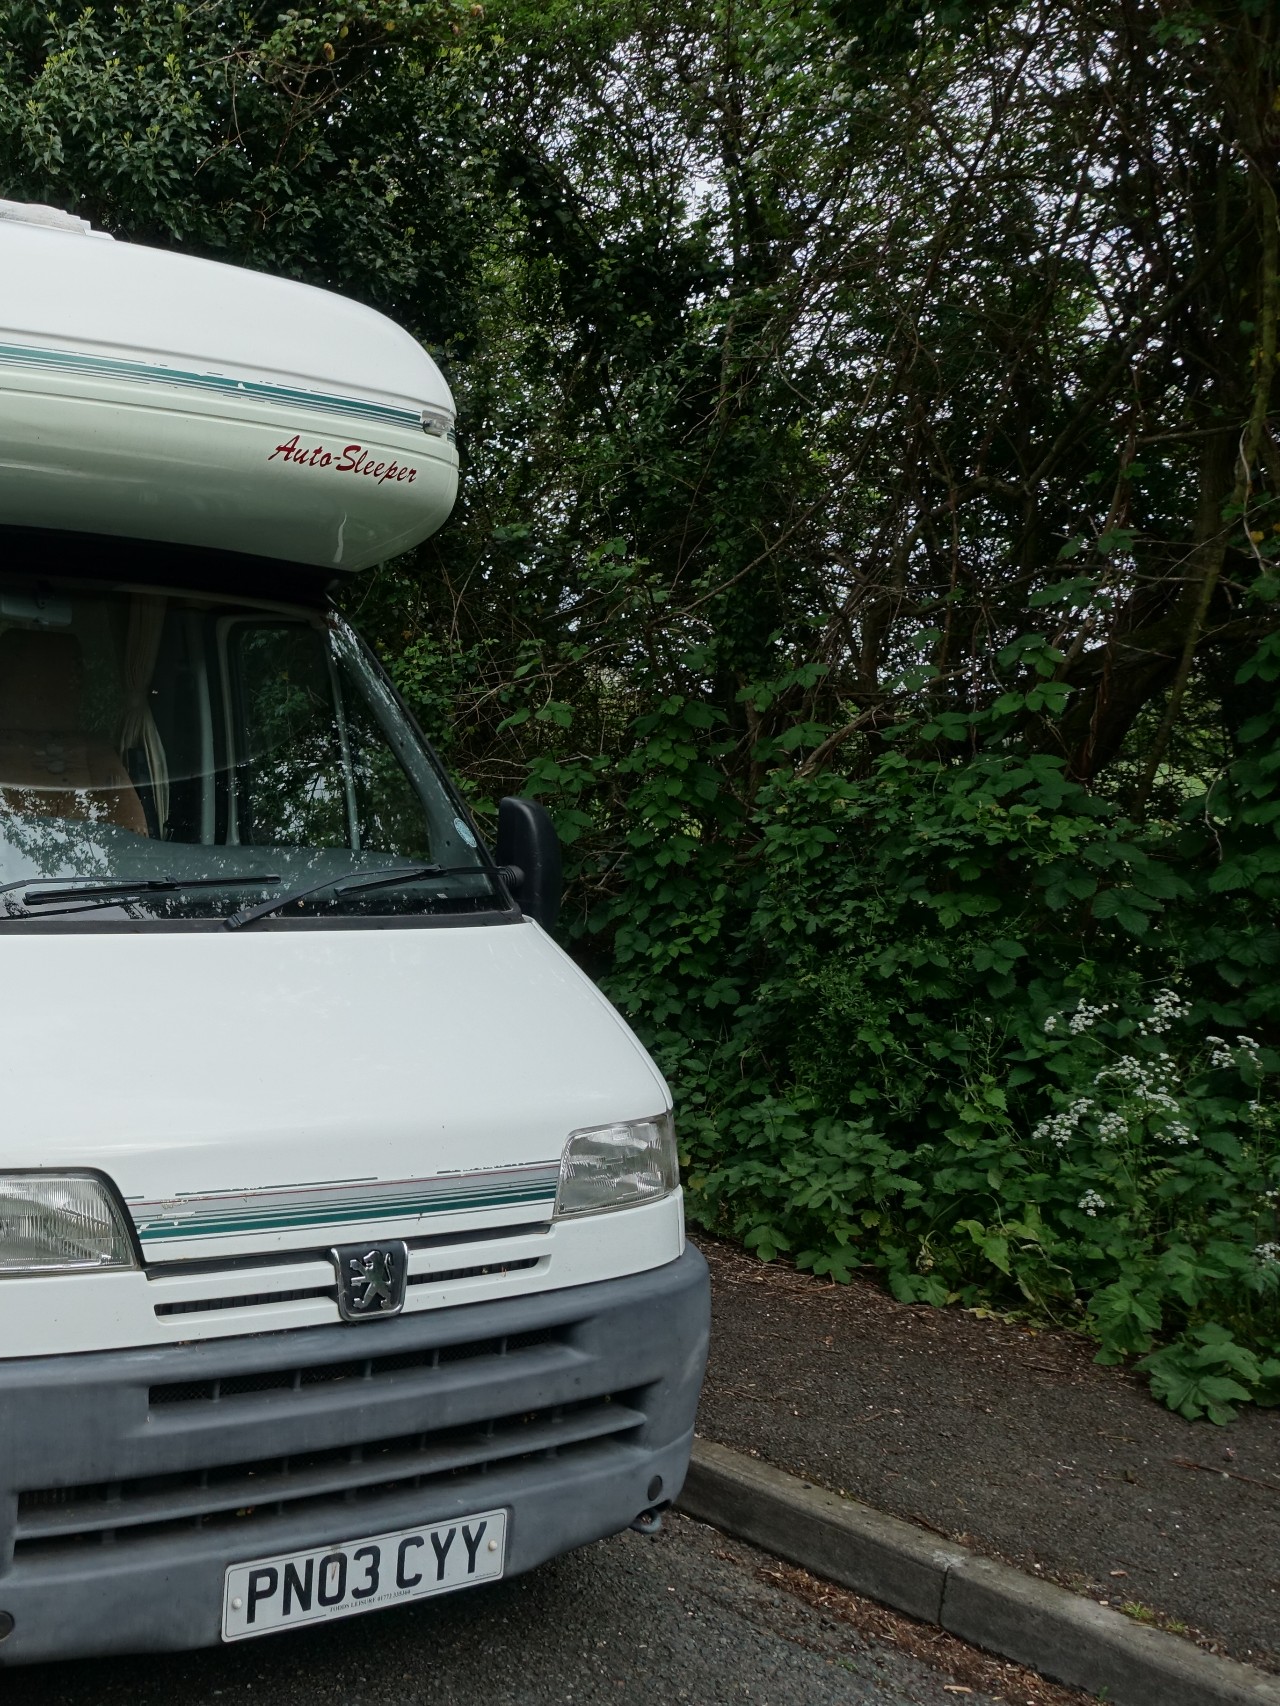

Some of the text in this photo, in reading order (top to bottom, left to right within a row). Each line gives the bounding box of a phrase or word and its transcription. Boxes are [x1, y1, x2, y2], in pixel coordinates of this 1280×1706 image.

[267, 434, 417, 485] Auto-Sleeper
[246, 1521, 488, 1624] PN03 CYY
